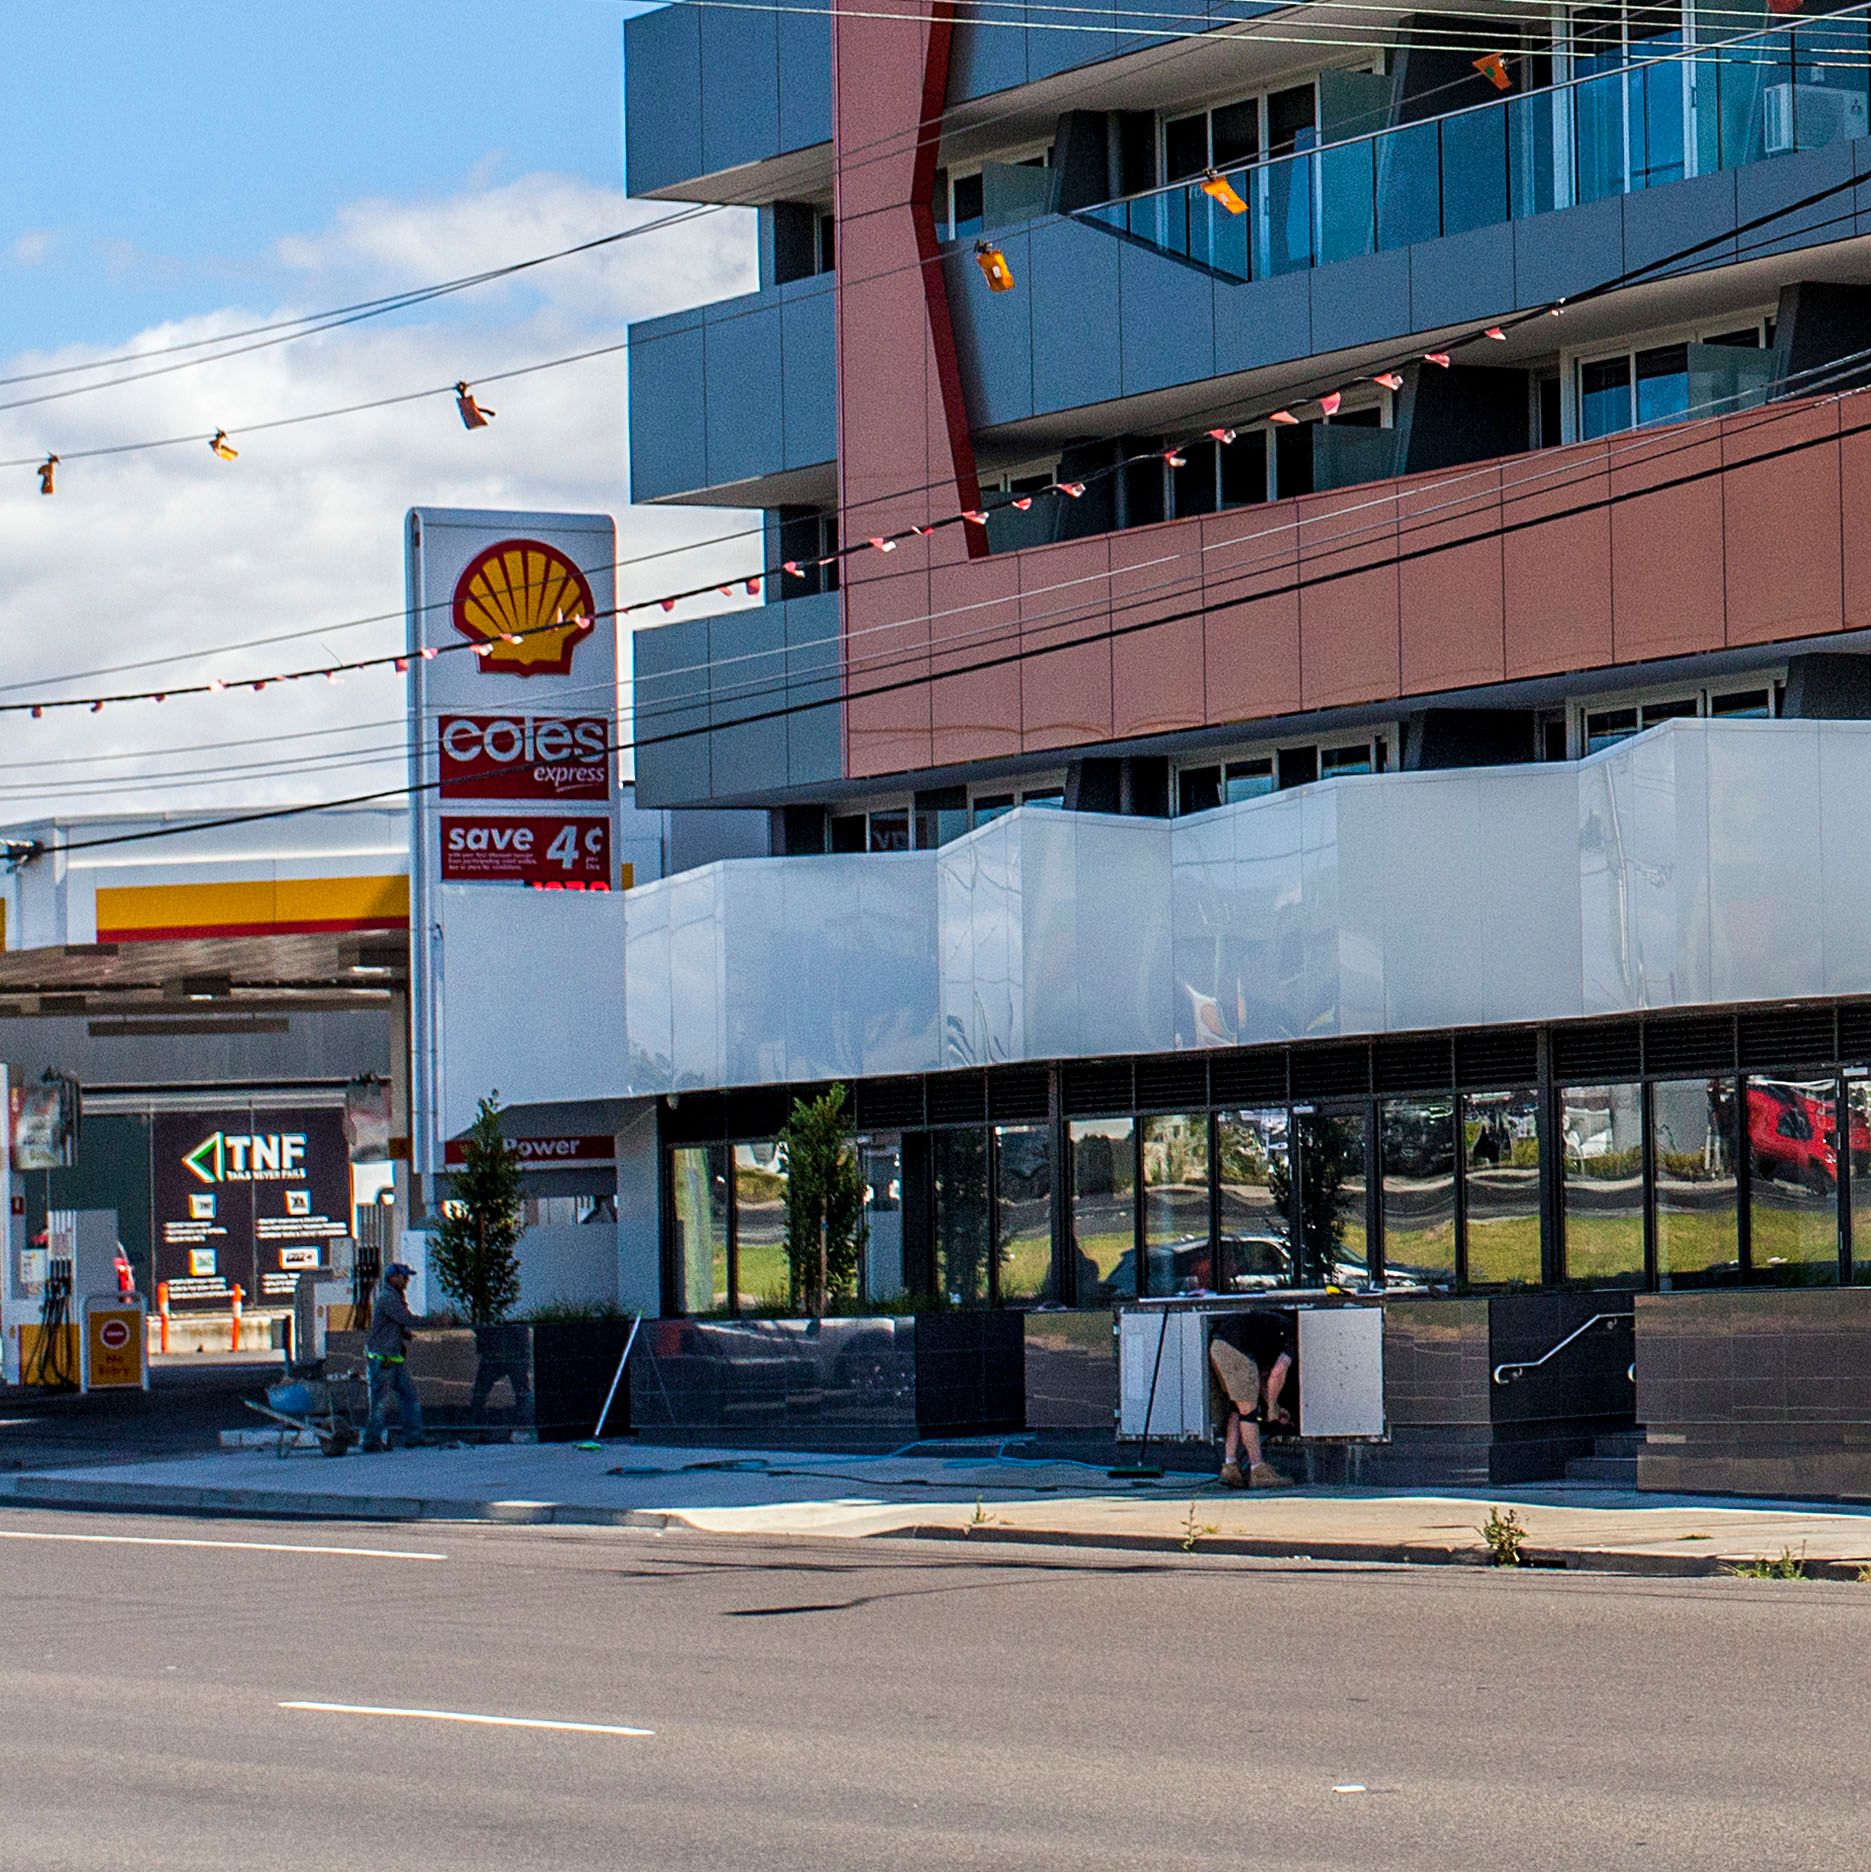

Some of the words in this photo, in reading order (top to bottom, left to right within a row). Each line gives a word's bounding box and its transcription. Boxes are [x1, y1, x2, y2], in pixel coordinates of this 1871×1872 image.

[442, 716, 606, 764] coles
[533, 766, 606, 788] express
[448, 826, 535, 852] save
[224, 1133, 308, 1172] TNF
[479, 1137, 581, 1157] Power
